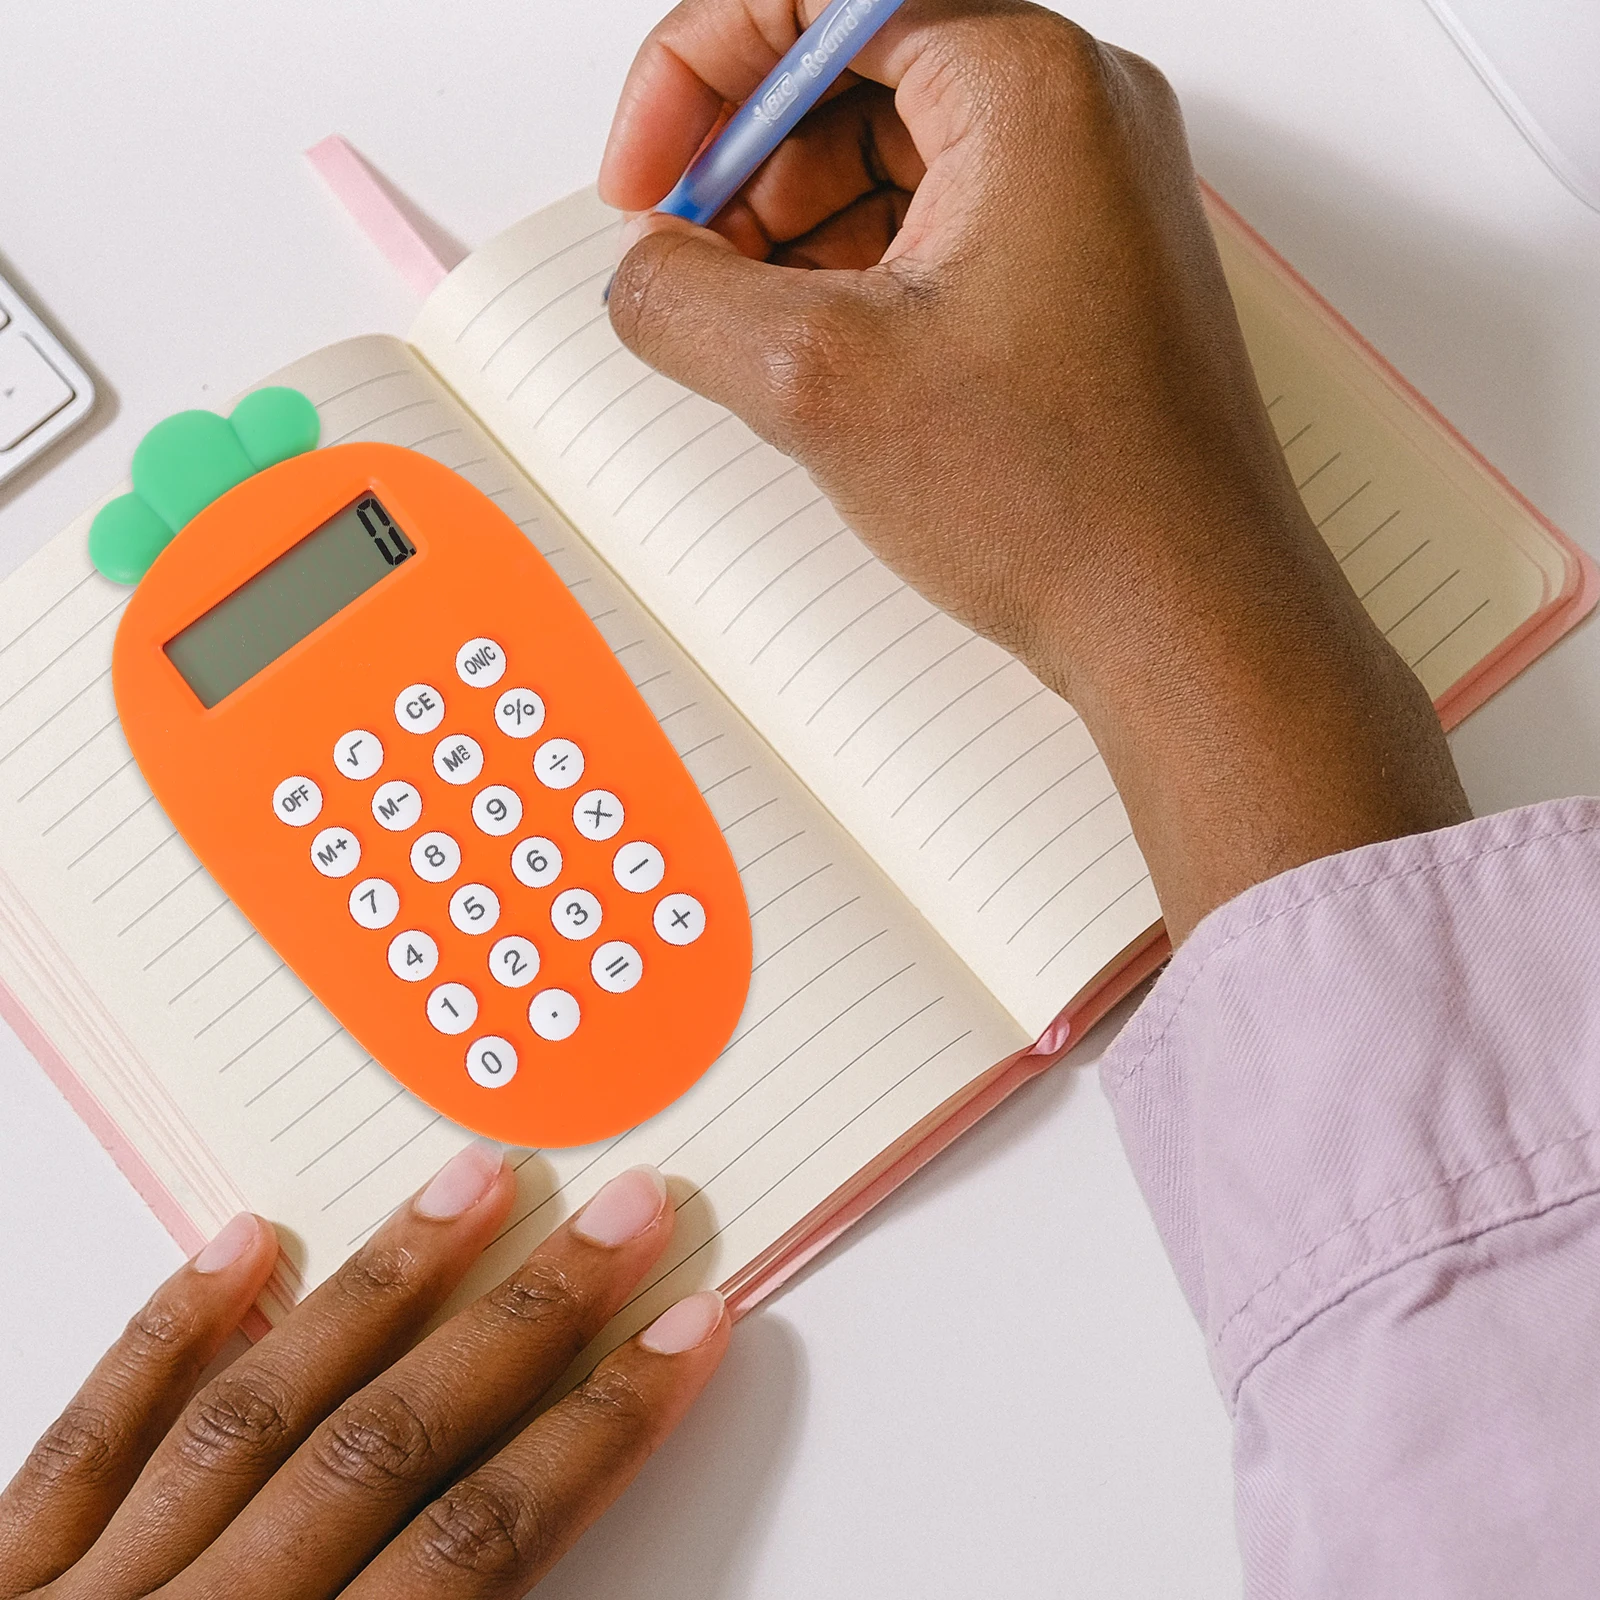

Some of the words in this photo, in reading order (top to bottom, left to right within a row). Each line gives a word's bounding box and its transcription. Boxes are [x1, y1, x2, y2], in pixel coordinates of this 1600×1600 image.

[801, 6, 858, 78] Round
[281, 785, 311, 814] OFF
[405, 692, 436, 720] CE
[463, 645, 497, 676] ON/C
[316, 838, 348, 867] M+
[502, 698, 536, 726] %
[359, 889, 378, 915] 7
[425, 845, 446, 868] 8
[486, 798, 508, 822] 9
[406, 943, 424, 967] 4
[463, 896, 486, 921] 5
[526, 850, 549, 873] 6
[440, 997, 460, 1018] 1
[503, 949, 528, 976] 2
[565, 902, 589, 926] 3
[481, 1051, 503, 1075] 0
